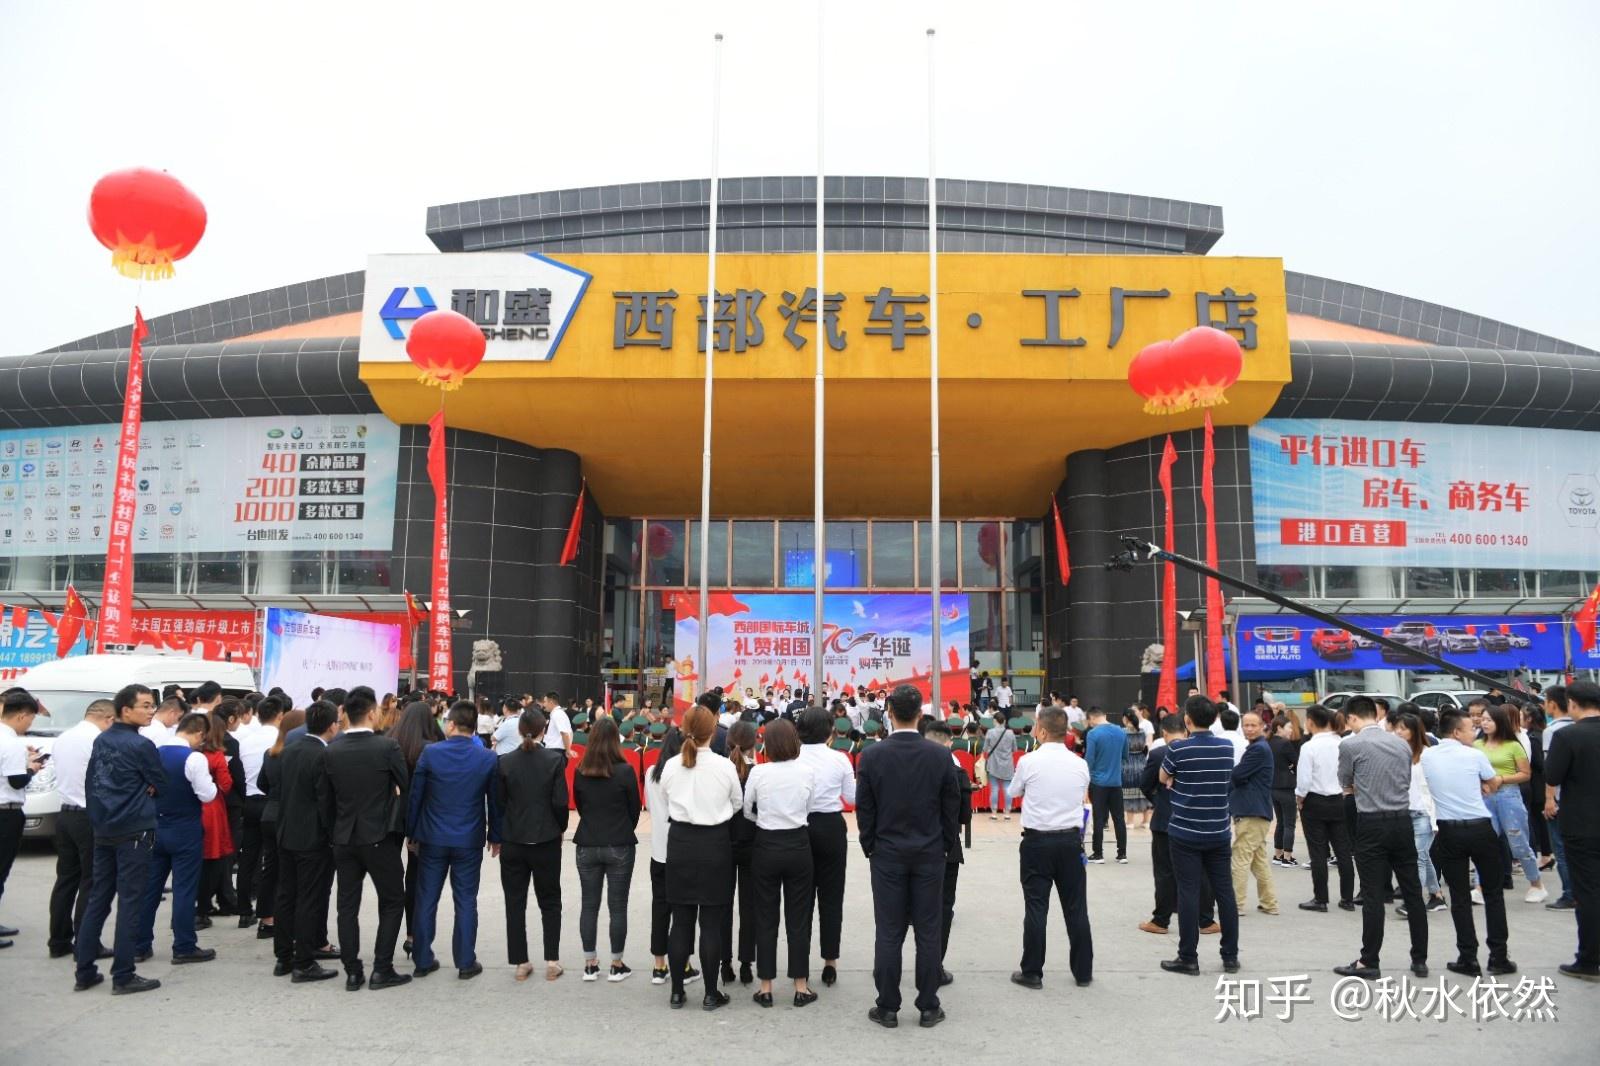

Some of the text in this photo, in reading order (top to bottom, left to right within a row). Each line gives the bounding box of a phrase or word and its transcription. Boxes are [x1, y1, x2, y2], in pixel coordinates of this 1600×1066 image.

[451, 287, 552, 325] 和盛
[480, 327, 550, 341] SHENG
[1280, 435, 1426, 468] 平行进口车
[262, 453, 359, 473] 40 余种品牌
[245, 477, 359, 497] 200 多款车型
[234, 502, 358, 522] 1000 多款配置
[1568, 507, 1597, 515] TOYOTA
[1297, 522, 1392, 544] 港口直营
[1449, 533, 1472, 545] 400
[1475, 534, 1497, 545] 600
[1500, 535, 1528, 546] 1340
[733, 621, 810, 634] 西部国际车城
[734, 636, 811, 657] 礼赞祖国
[872, 637, 912, 657] 华诞
[1254, 645, 1301, 655] 吉利汽车
[858, 657, 895, 670] 购车节
